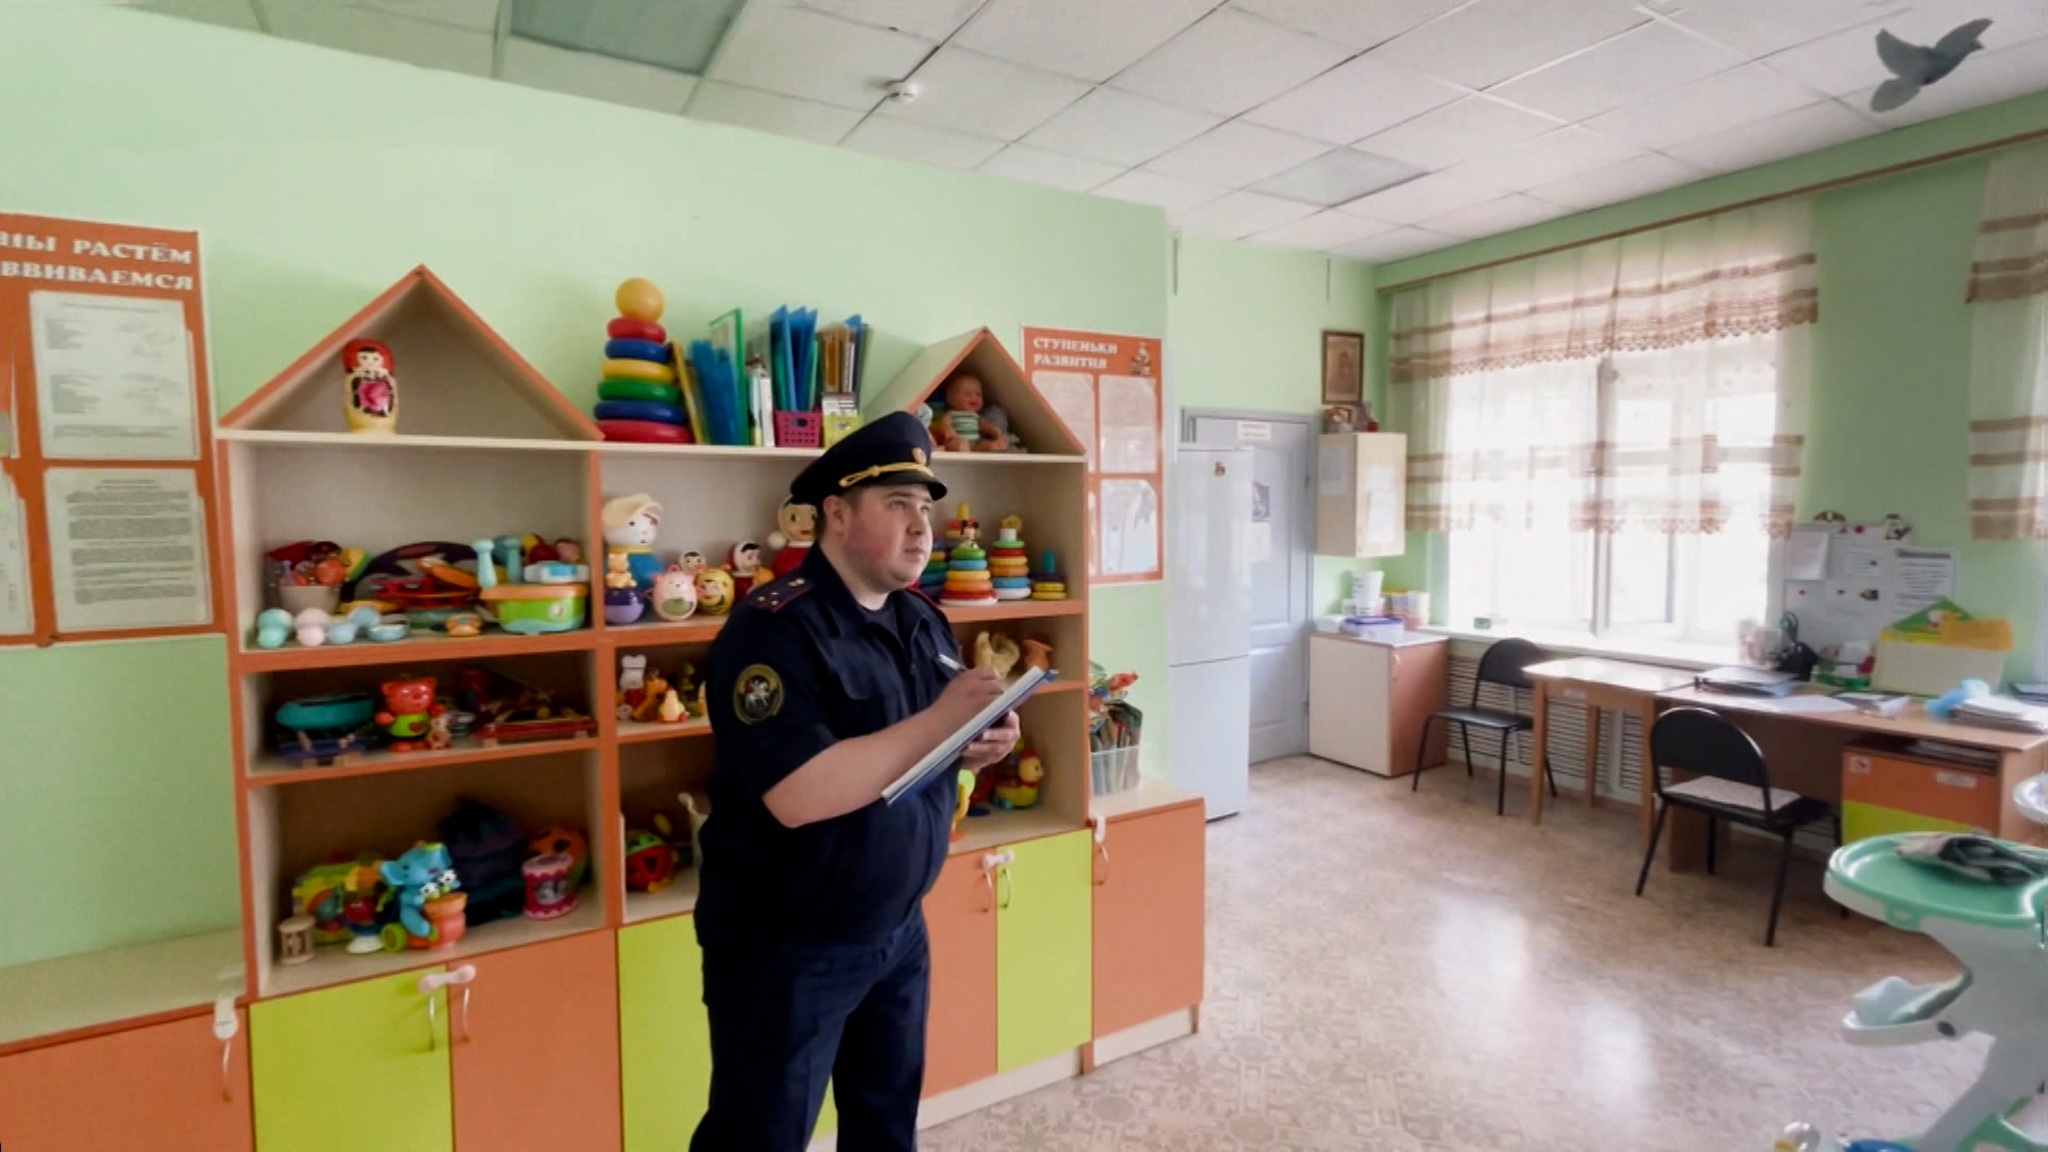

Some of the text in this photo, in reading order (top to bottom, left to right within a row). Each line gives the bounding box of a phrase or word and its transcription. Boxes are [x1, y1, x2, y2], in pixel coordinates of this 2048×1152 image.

[72, 238, 192, 265] РАСТЁМ
[1033, 336, 1118, 354] СТУПЕНЬКИ
[1033, 353, 1107, 370] РАЗВИТИЯ
